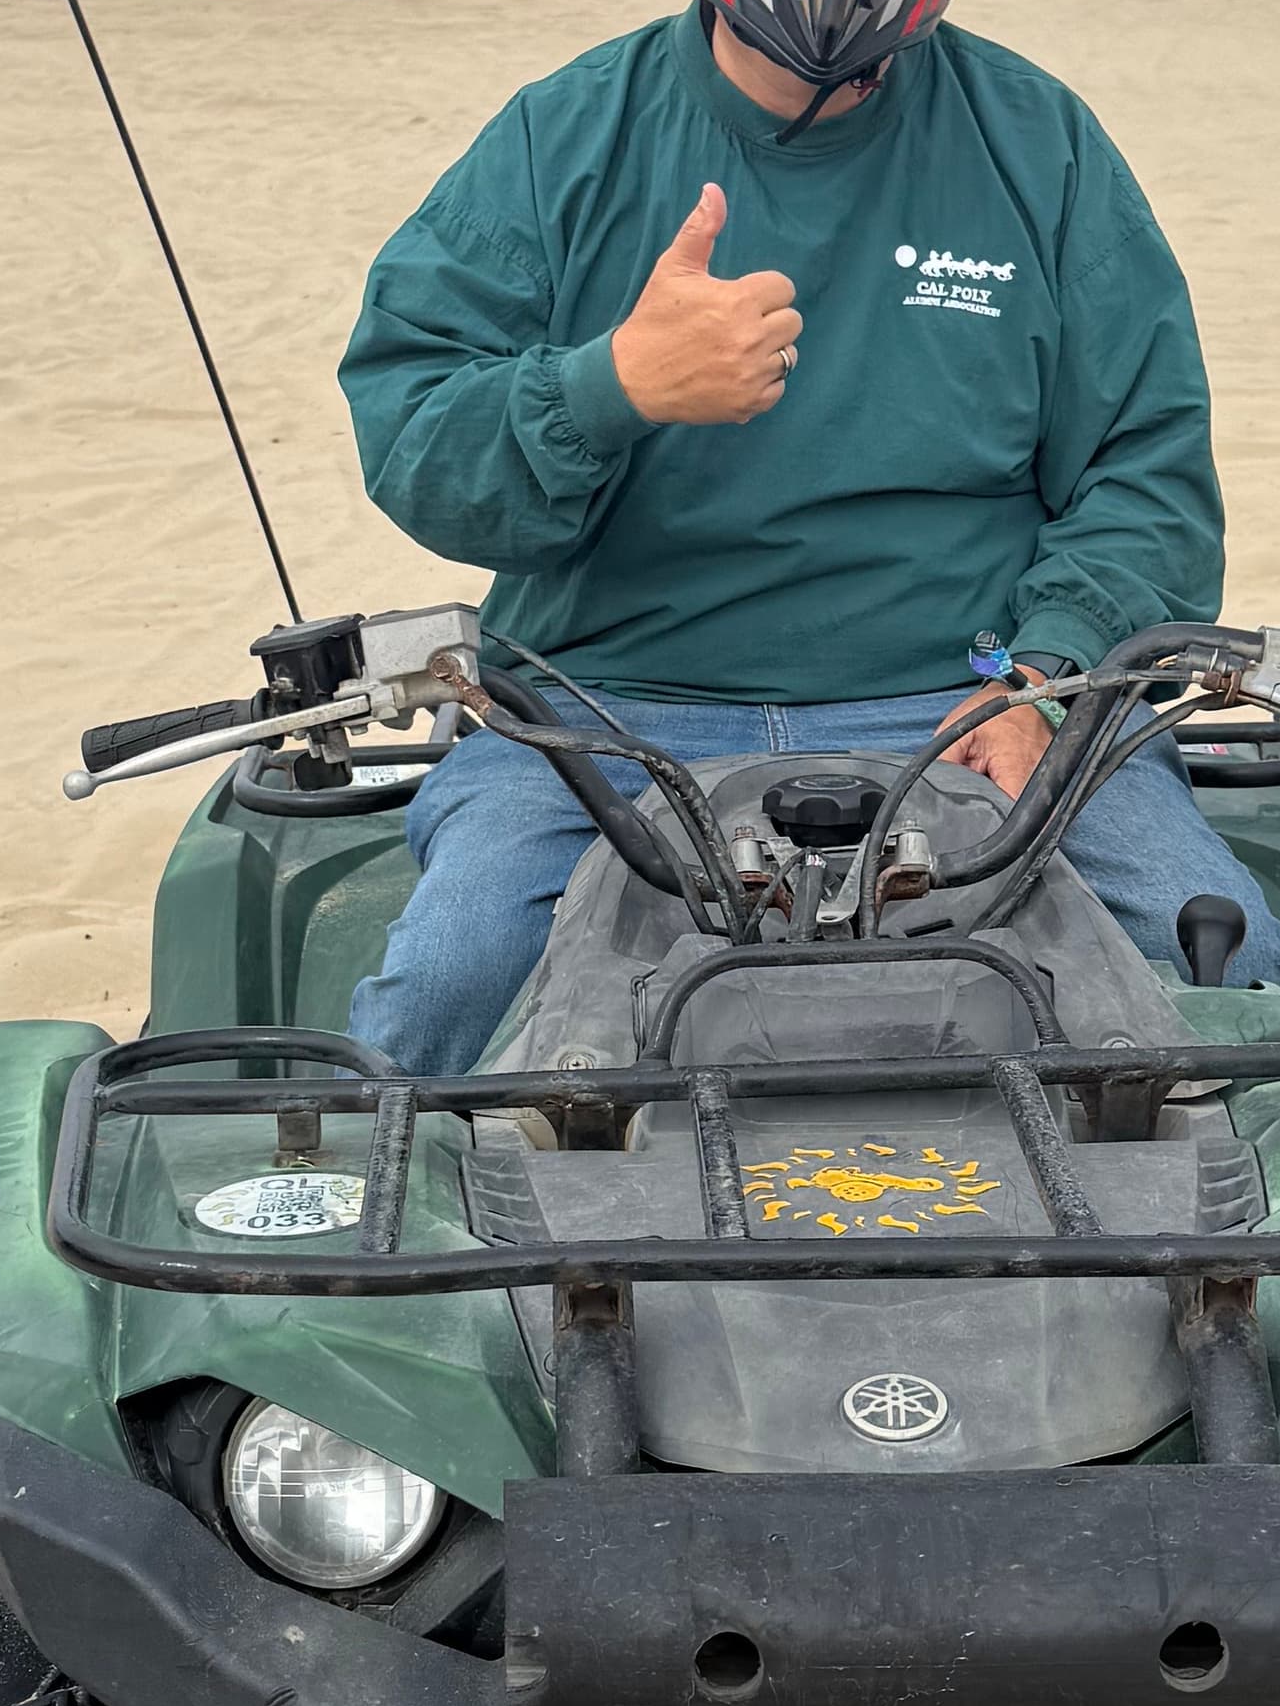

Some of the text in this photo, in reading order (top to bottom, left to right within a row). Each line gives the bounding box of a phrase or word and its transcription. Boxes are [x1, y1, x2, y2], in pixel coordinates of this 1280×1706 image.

[917, 282, 992, 304] CAL POLY
[260, 1178, 325, 1191] QL
[247, 1212, 327, 1229] 033
